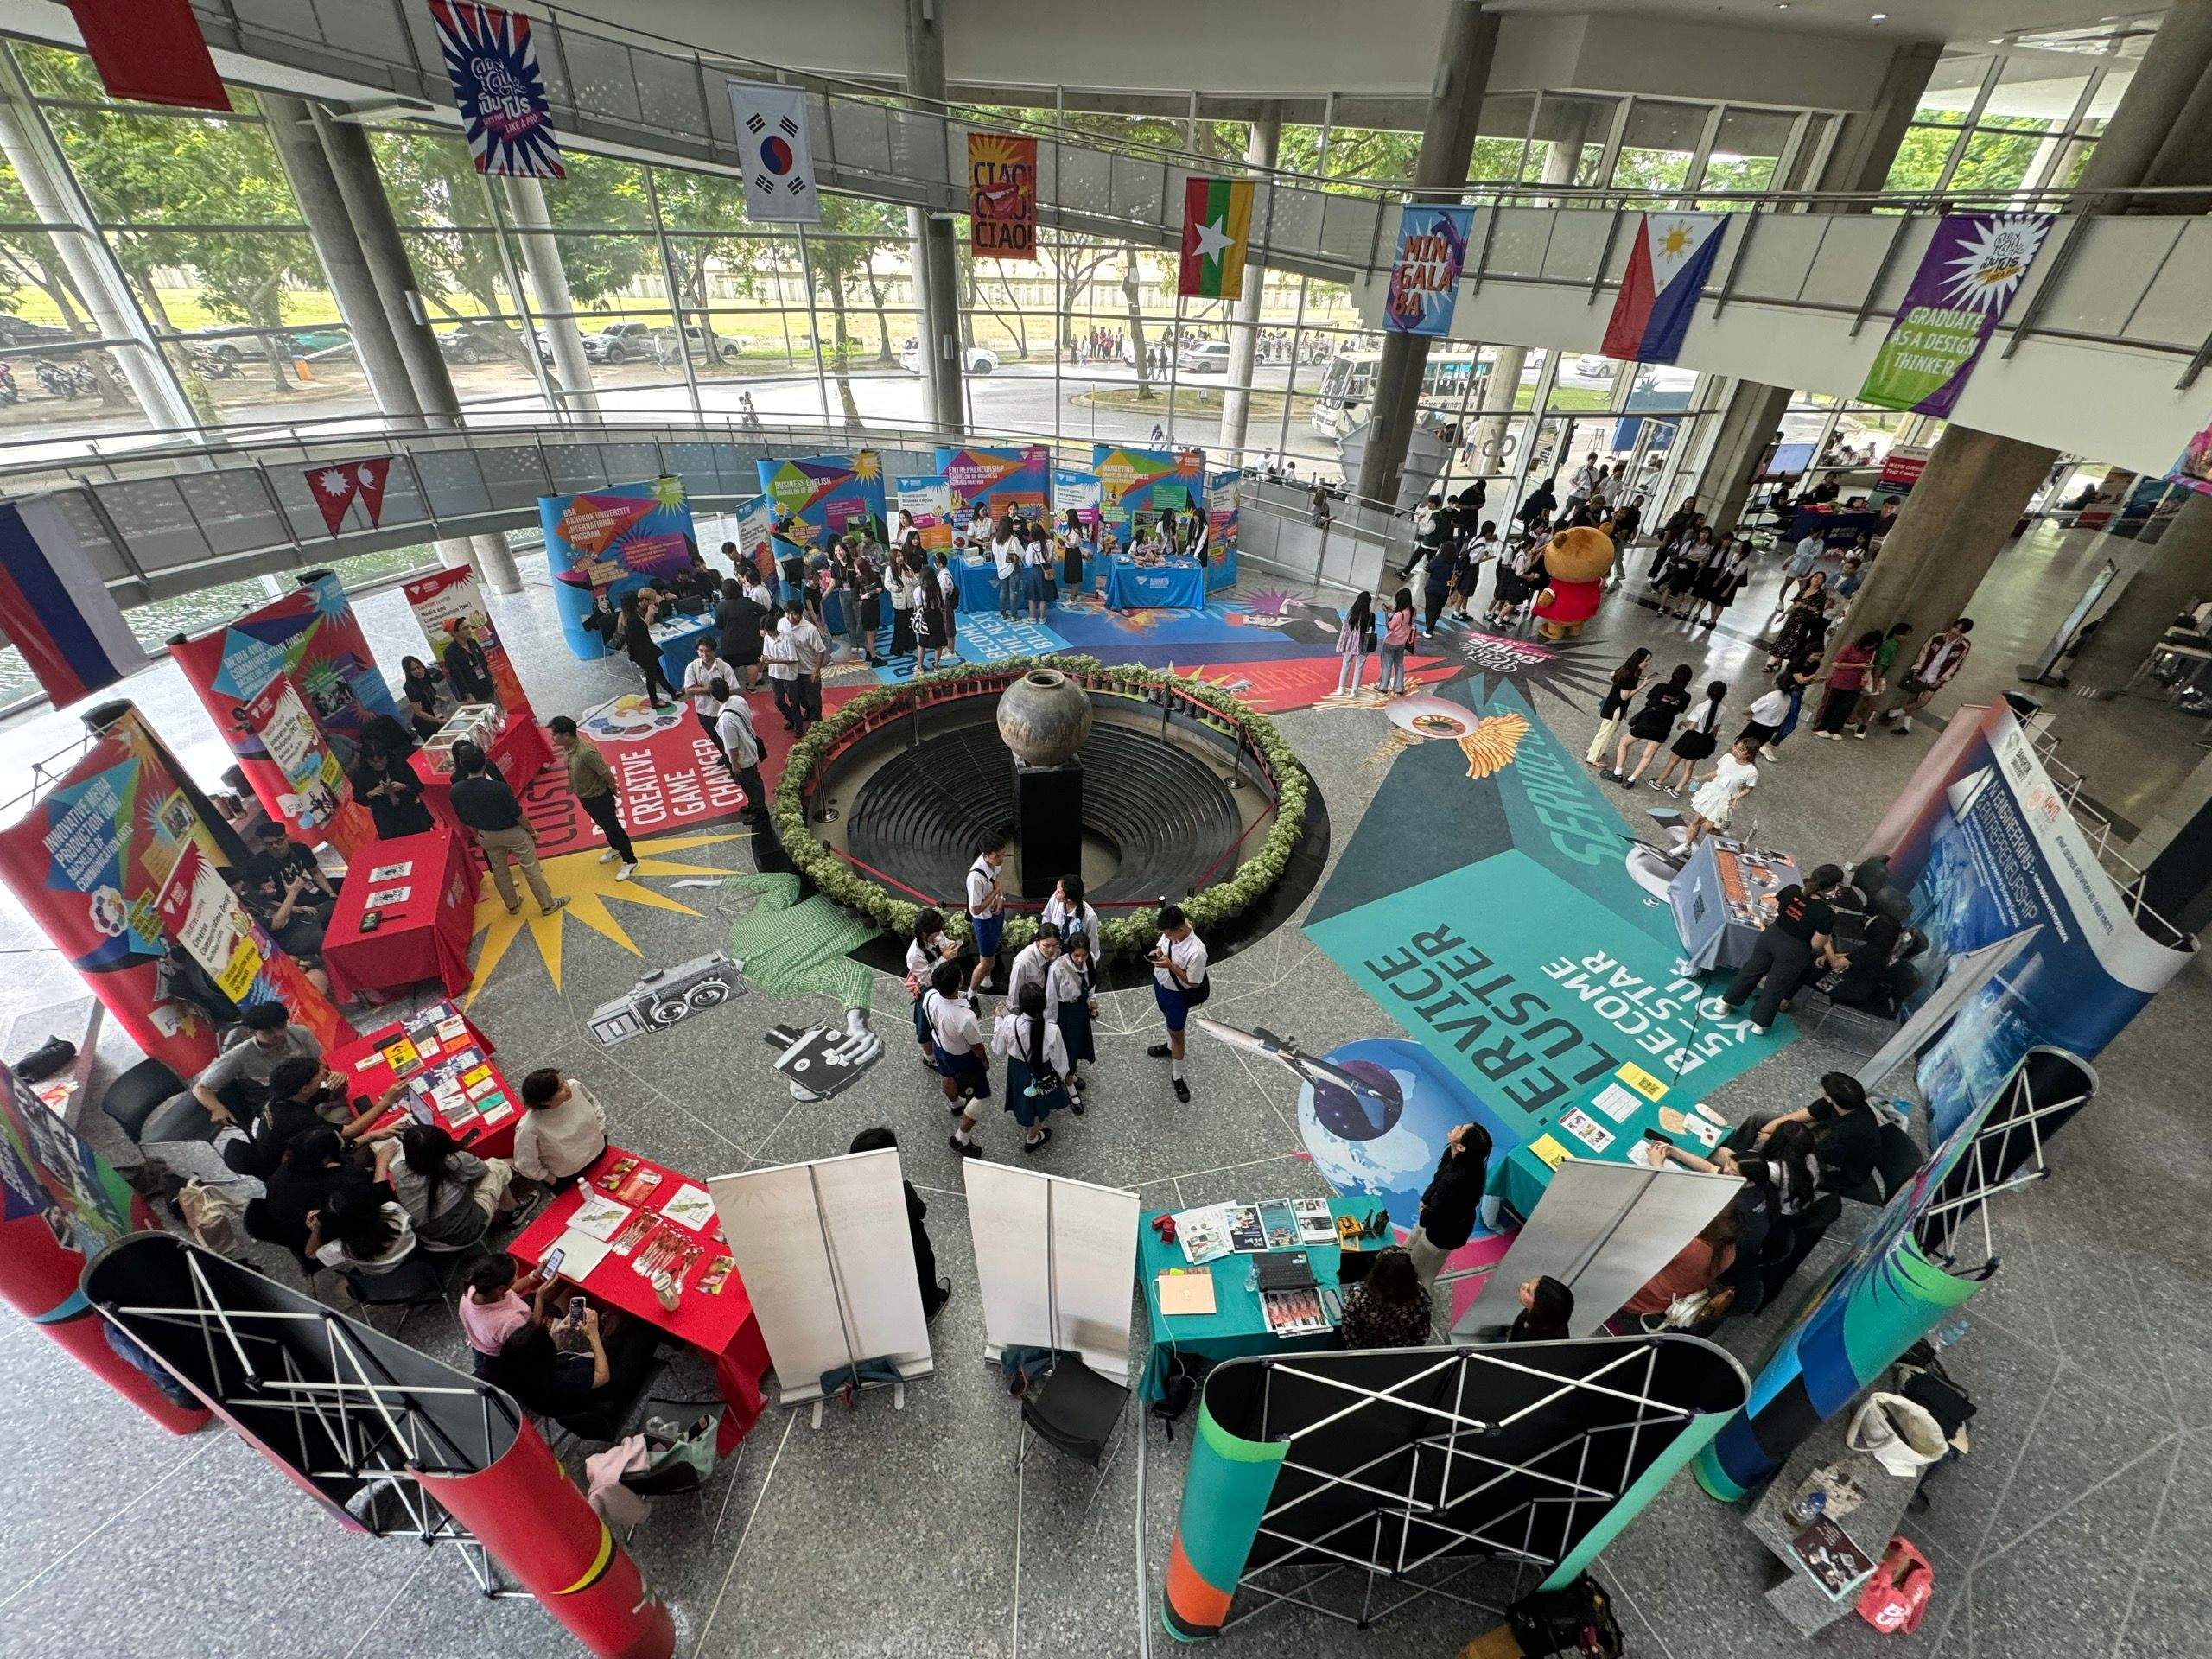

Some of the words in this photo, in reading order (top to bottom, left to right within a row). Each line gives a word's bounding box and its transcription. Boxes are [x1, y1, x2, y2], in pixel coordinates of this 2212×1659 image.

[505, 124, 520, 133] LIKE
[520, 119, 526, 128] A
[526, 114, 538, 125] PRO
[976, 221, 1032, 250] CIAO!
[1402, 235, 1448, 263] MIN
[1400, 264, 1452, 292] GALA
[1394, 290, 1421, 316] BA
[1908, 306, 1987, 332] GRADUATE
[1891, 329, 1910, 346] AS
[1910, 332, 1923, 348] A
[1924, 334, 1981, 355] DESIGN
[775, 480, 805, 490] BUSINESS
[806, 477, 831, 486] ENGLISH
[948, 465, 1005, 474] ENTREPRENEURSHIP
[776, 487, 800, 496] BACHELOR
[563, 508, 576, 518] BBA
[565, 512, 594, 526] BANGKOK
[594, 506, 631, 518] UNIVERSITY
[567, 518, 616, 535] INTERNATIONAL
[570, 530, 601, 542] PROGRAM
[968, 613, 1007, 634] NEXT
[224, 650, 248, 666] MEDIA
[247, 640, 264, 658] AND
[957, 623, 1008, 659] BECOME
[229, 642, 287, 680] COMMUNICATION
[620, 748, 667, 825] CREATIVE
[664, 767, 706, 816] GAME
[42, 798, 92, 854] INNOVATIVE
[85, 777, 111, 808] MEDIA
[1516, 745, 1626, 865] SERVICE
[54, 814, 105, 868] PRODUCTION
[1991, 791, 2037, 872] ENGINEERING
[67, 842, 102, 880] BACHELOR
[93, 834, 105, 850] OF
[76, 833, 122, 892] COMMUNICATION
[115, 822, 134, 847] ARTS
[1978, 805, 2040, 921] ENTREPRENEURSHIP
[192, 923, 208, 948] Creative
[199, 912, 223, 956] Communication
[219, 893, 232, 917] Design
[1411, 923, 1621, 1085] LUSTER
[1540, 957, 1707, 1076] BECOME
[1581, 950, 1733, 1058] 5-STAR
[1363, 946, 1573, 1126] ERVICE
